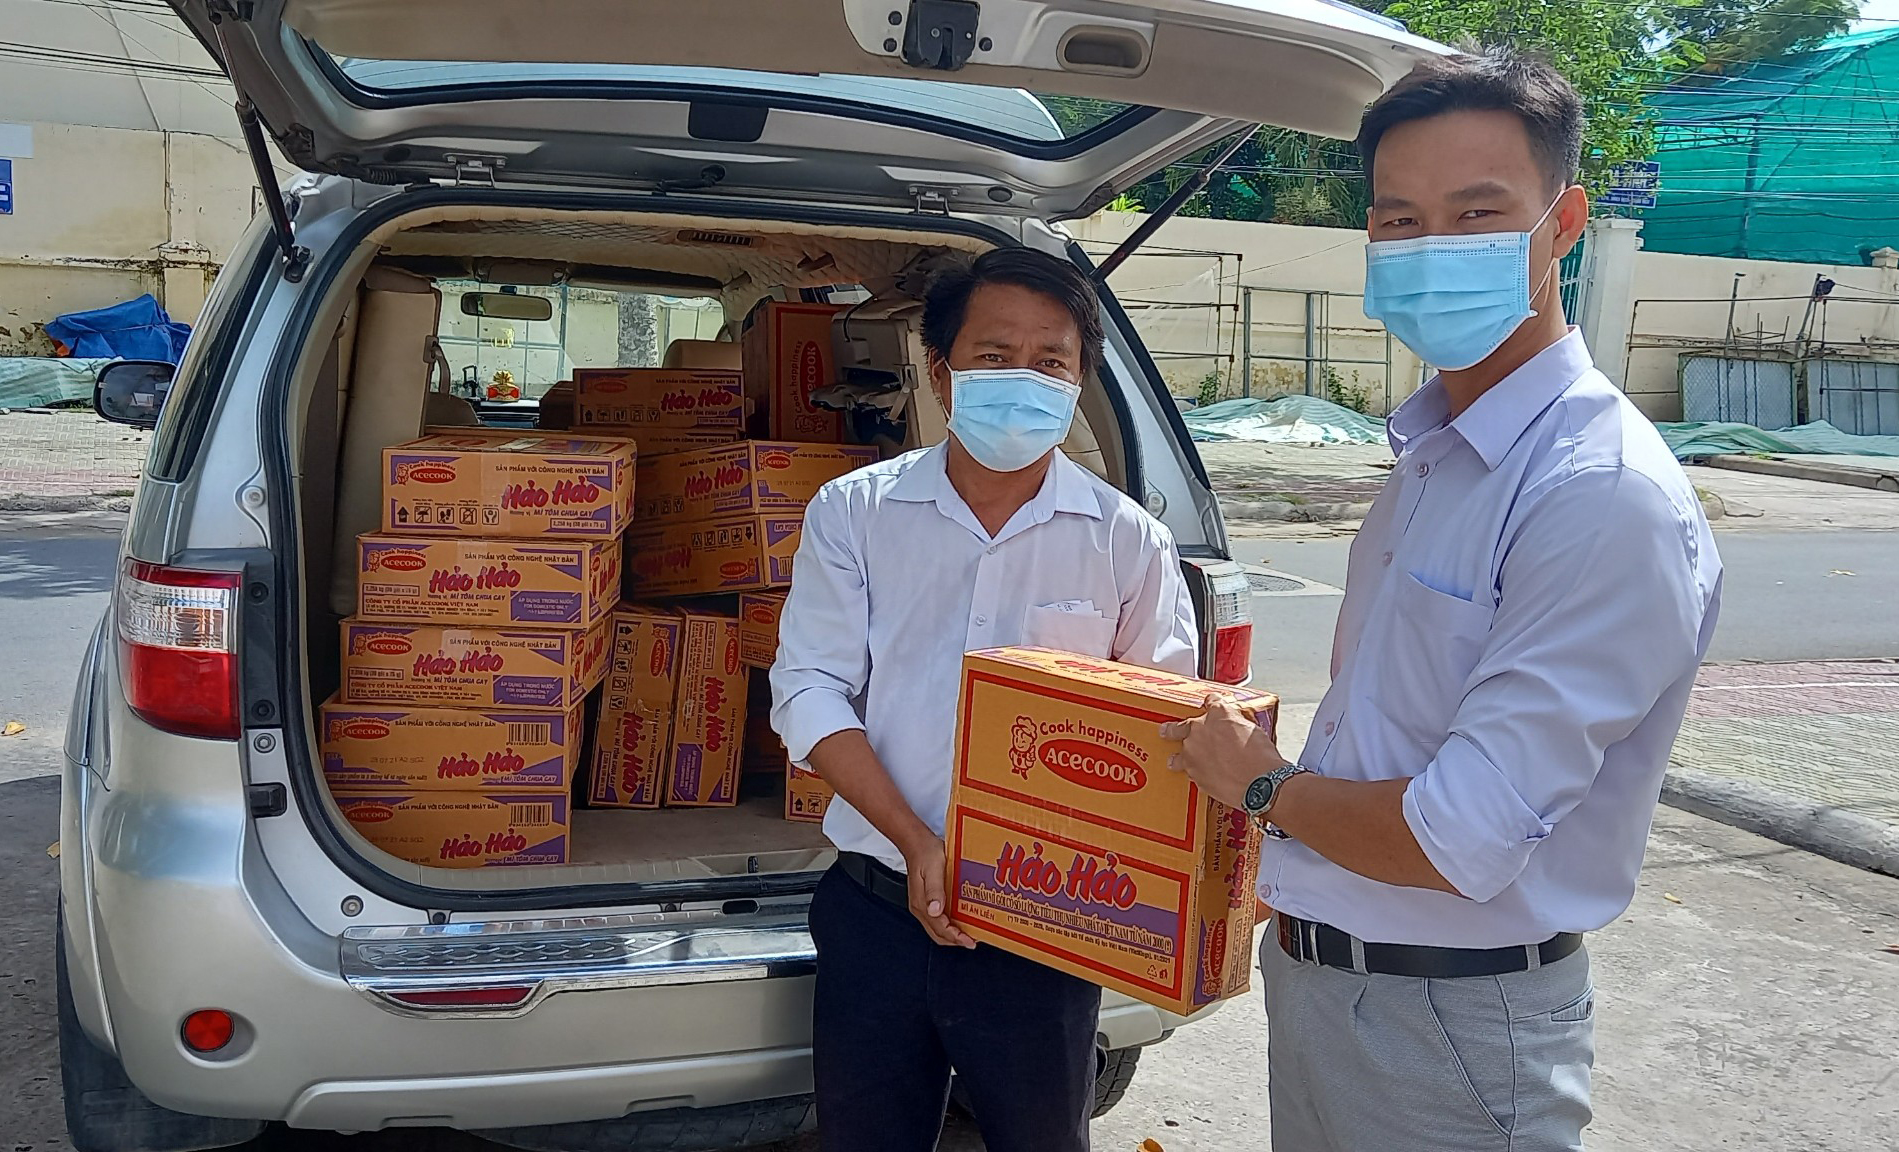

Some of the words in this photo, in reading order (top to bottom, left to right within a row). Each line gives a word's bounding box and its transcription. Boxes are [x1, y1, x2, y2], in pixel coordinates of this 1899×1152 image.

[807, 346, 816, 392] eCOOK
[501, 479, 549, 510] Hảo
[552, 475, 600, 506] Hảo
[428, 565, 473, 594] Hảo
[476, 561, 522, 590] Hảo
[413, 649, 456, 677] Hảo
[459, 646, 504, 674] Hảo
[704, 676, 728, 714] Hảo
[622, 712, 647, 751] Hảo
[705, 715, 728, 752] Hảo
[1040, 718, 1075, 736] Cook
[1078, 719, 1149, 763] happiness
[437, 752, 480, 779] Hảo
[482, 747, 525, 775] Hảo
[621, 754, 647, 794] Hảo
[440, 833, 482, 860] Hảo
[485, 828, 527, 855] Hảo
[1223, 807, 1248, 852] Hả
[995, 841, 1062, 895] Hảo
[1066, 852, 1137, 909] Hảo
[1223, 854, 1246, 911] Hảo
[1114, 925, 1129, 941] NAM
